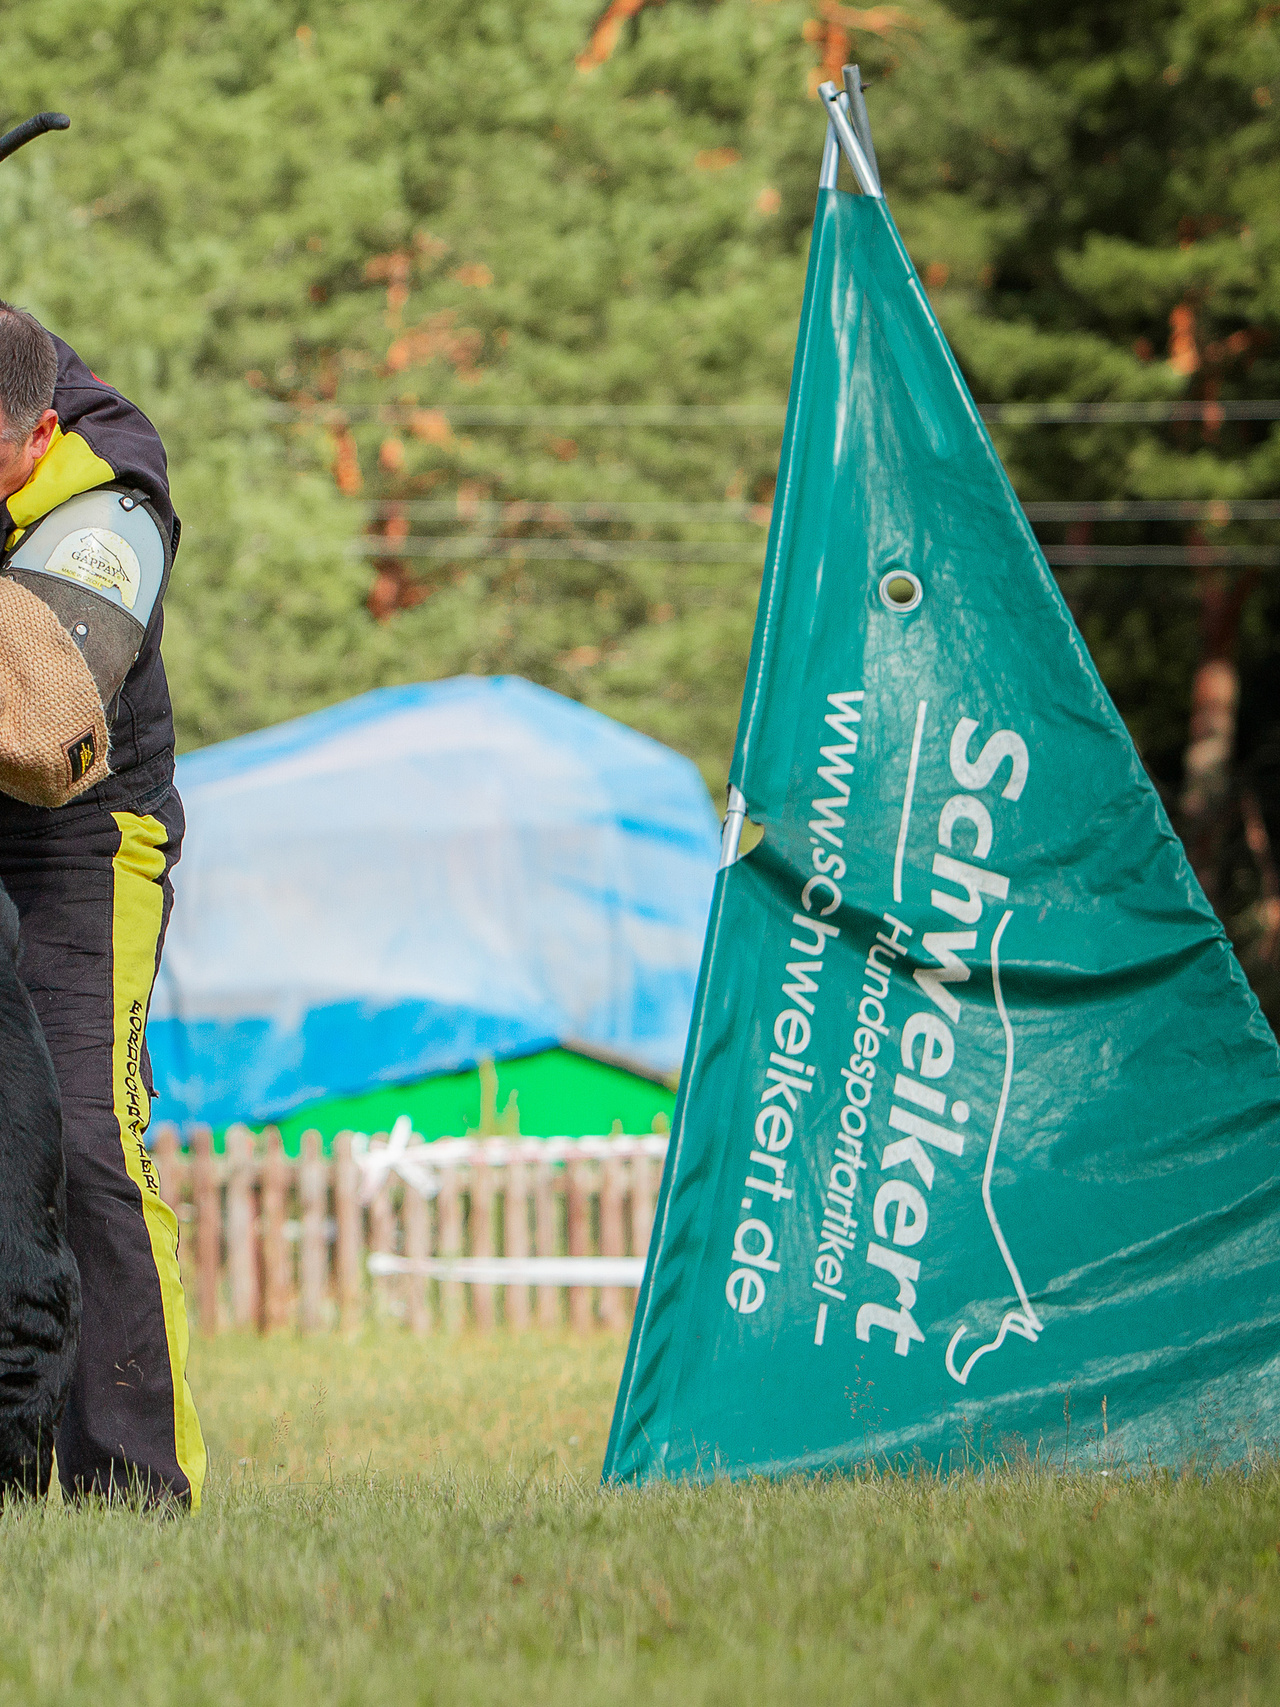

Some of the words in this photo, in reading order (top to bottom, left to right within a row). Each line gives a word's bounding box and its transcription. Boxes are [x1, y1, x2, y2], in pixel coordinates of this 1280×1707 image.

[71, 550, 120, 577] GAPPAY
[725, 690, 865, 1315] www.schweikert.de
[812, 911, 914, 1301] Hundesportartikel
[855, 716, 1030, 1357] Schweikert
